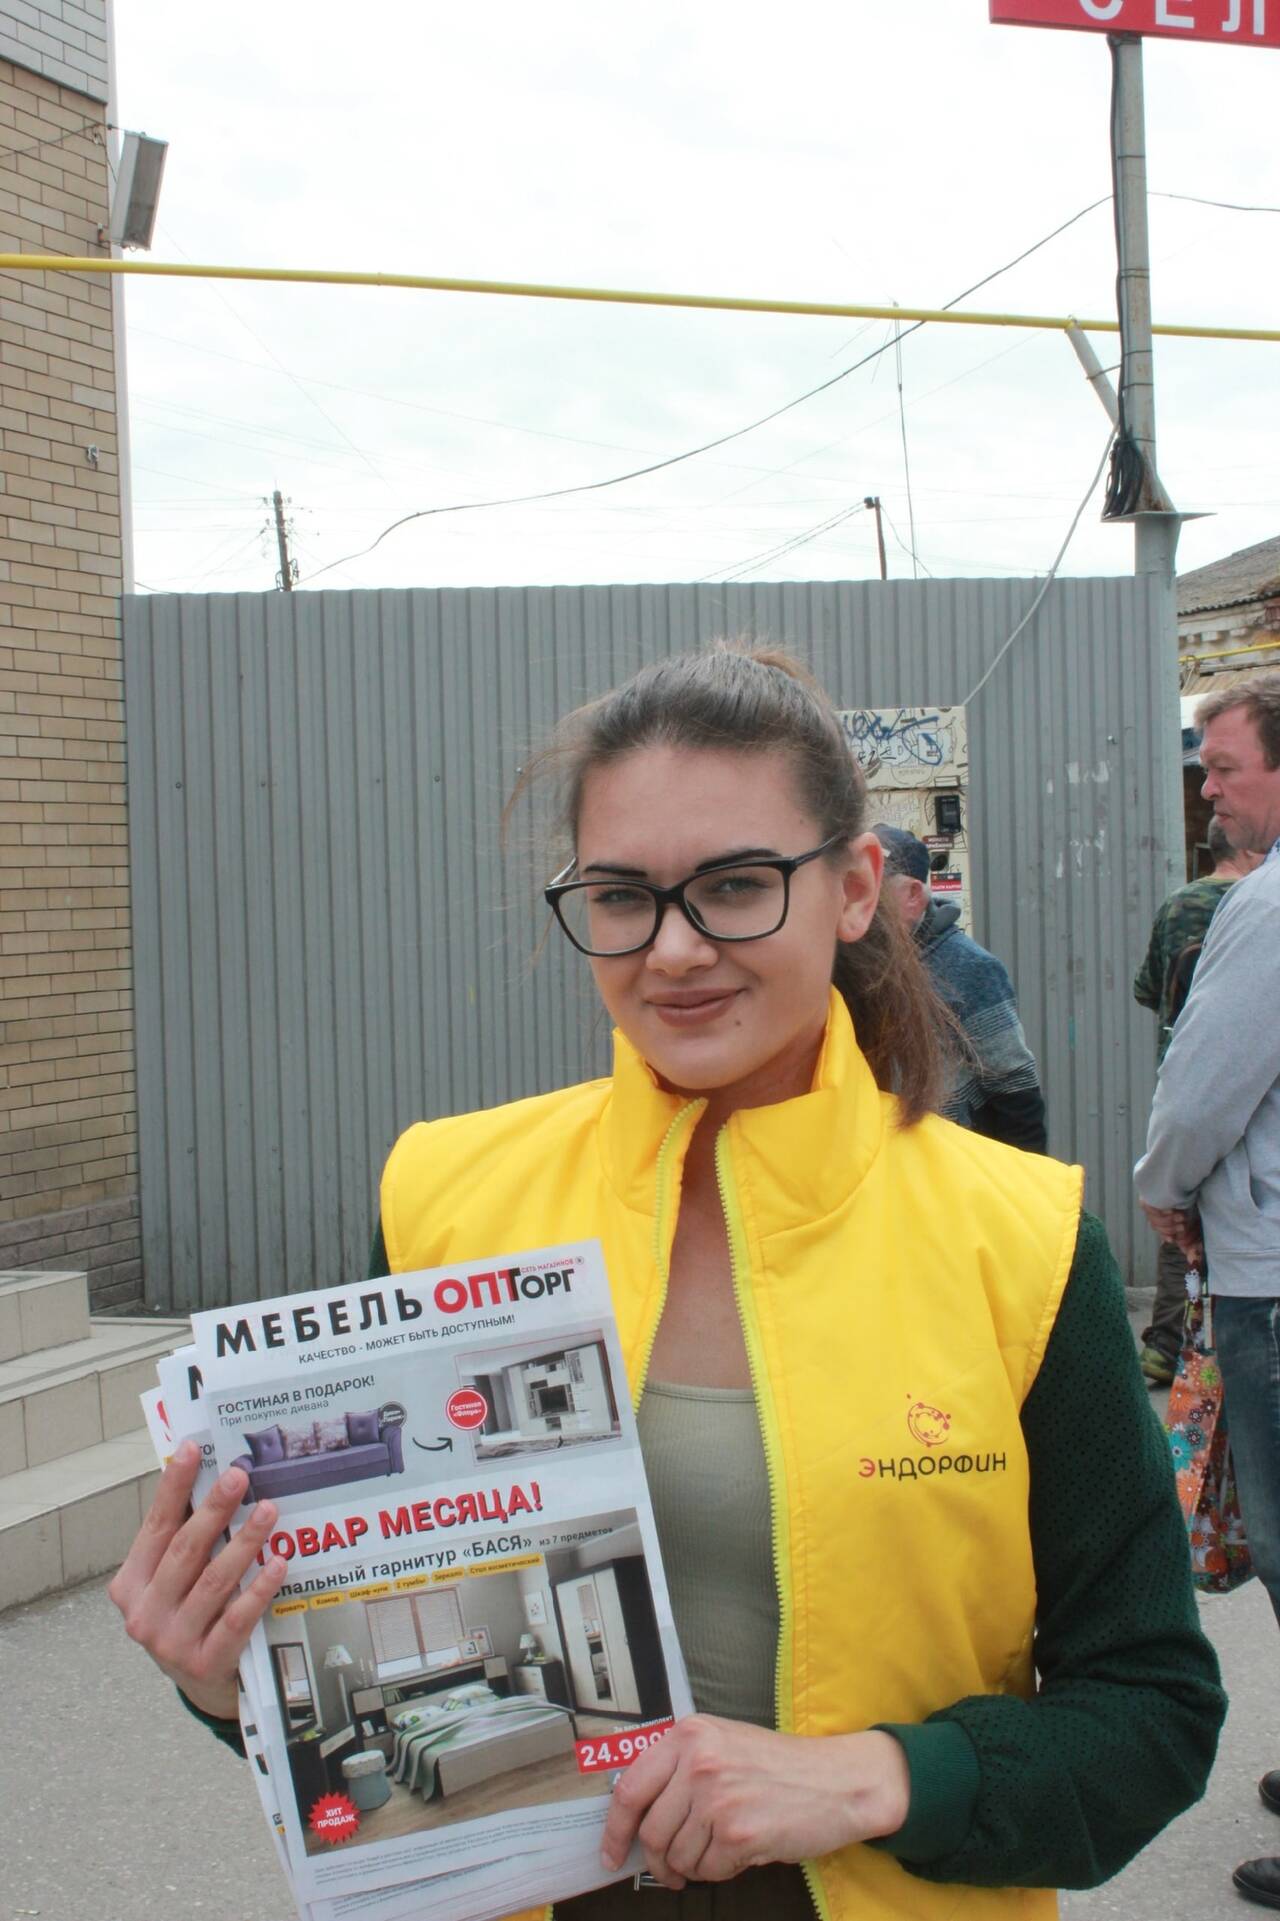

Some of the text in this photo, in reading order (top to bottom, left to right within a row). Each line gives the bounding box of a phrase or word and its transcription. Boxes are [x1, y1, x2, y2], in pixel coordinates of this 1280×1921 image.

[216, 1288, 423, 1358] МЕБЕЛЬ
[298, 1345, 357, 1364] КАЧЕСТВО
[366, 1334, 406, 1351] МОЖЕТ
[408, 1327, 438, 1341] БЫТЬ
[441, 1314, 515, 1337] ДОСТУПНЫМ!
[217, 1375, 375, 1415] ГОСТИНАЯ В ПОДАРОК!
[220, 1400, 329, 1428] При покупке дивана
[858, 1452, 1007, 1481] ЭНДОРФИН
[378, 1481, 544, 1540] МЕСЯЦА!
[372, 1549, 457, 1578] гарнитур
[463, 1535, 532, 1559] «БАСЯ»
[552, 1535, 558, 1544] 7
[561, 1526, 613, 1542] предметов
[317, 1814, 356, 1828] ПРОДАЖ
[325, 1807, 343, 1818] ХИТ
